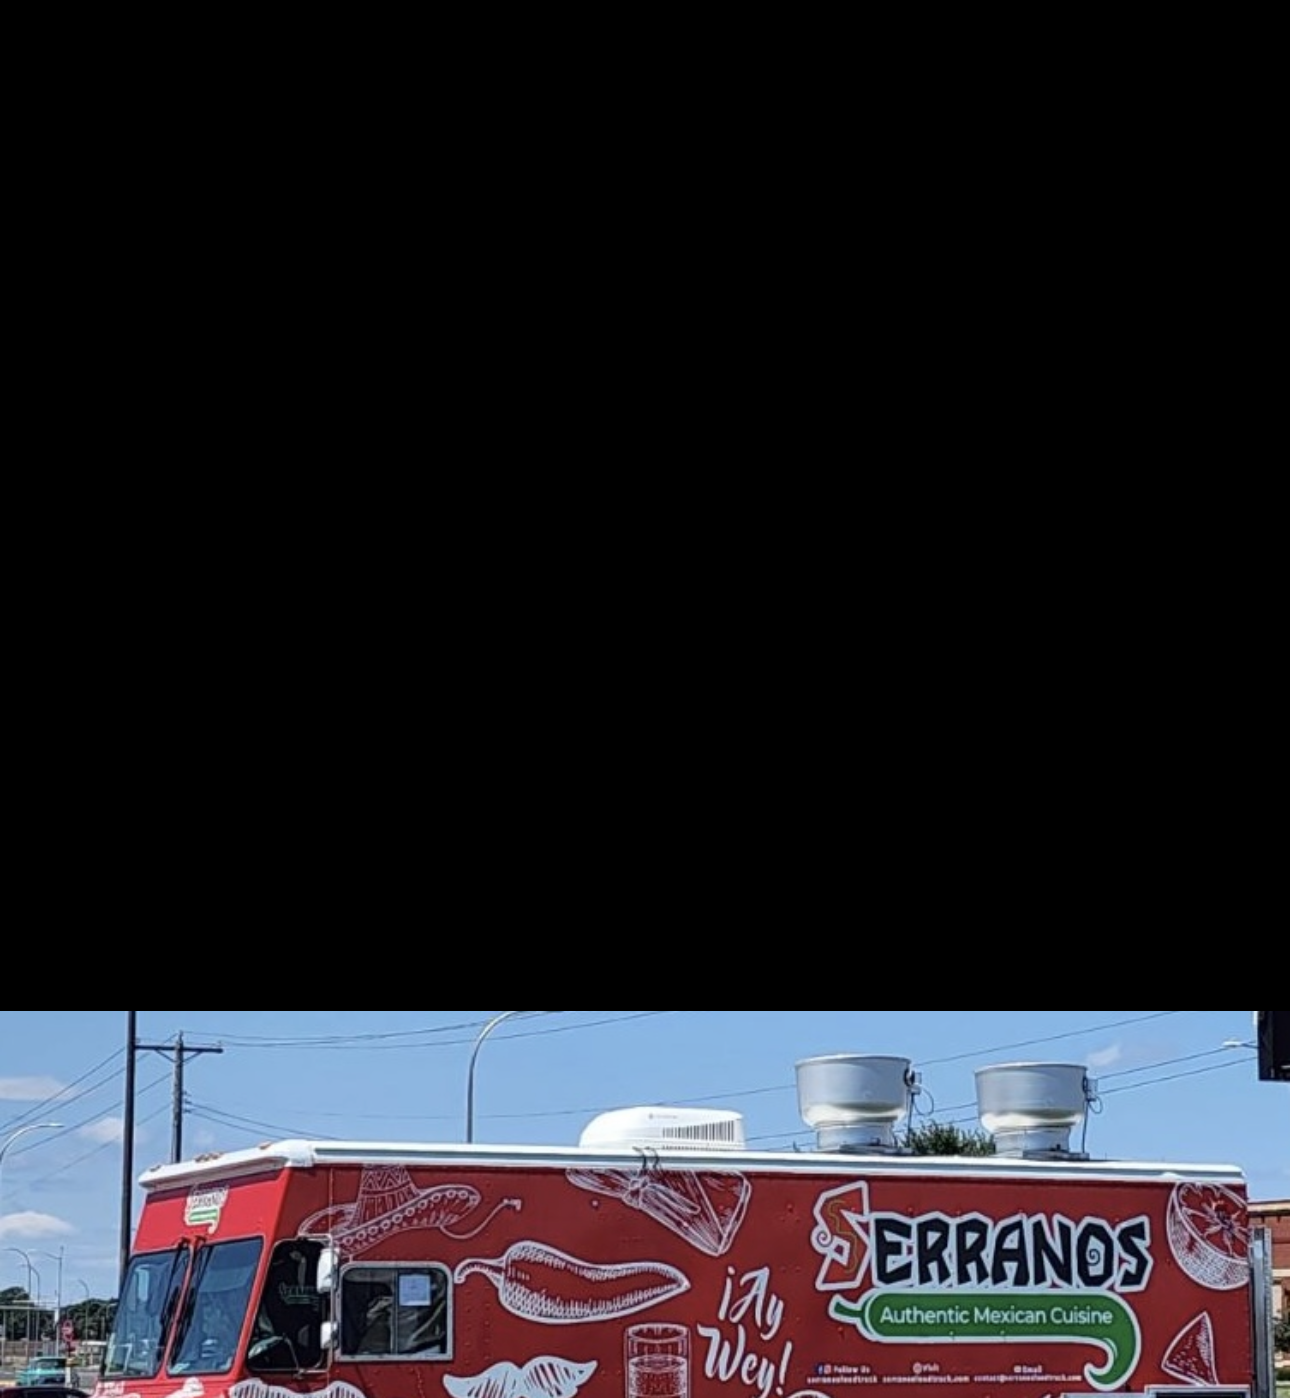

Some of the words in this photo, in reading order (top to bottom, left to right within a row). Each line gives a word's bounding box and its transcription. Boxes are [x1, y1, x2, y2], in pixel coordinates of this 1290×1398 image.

[811, 1180, 1153, 1291] SERRANOS
[717, 1265, 785, 1341] ¡Ay
[879, 1305, 970, 1325] Authentic
[974, 1305, 1047, 1325] Mexican
[1050, 1305, 1113, 1325] Cuisine
[833, 1365, 859, 1375] Follow
[860, 1365, 871, 1375] Us
[1022, 1364, 1043, 1374] Email
